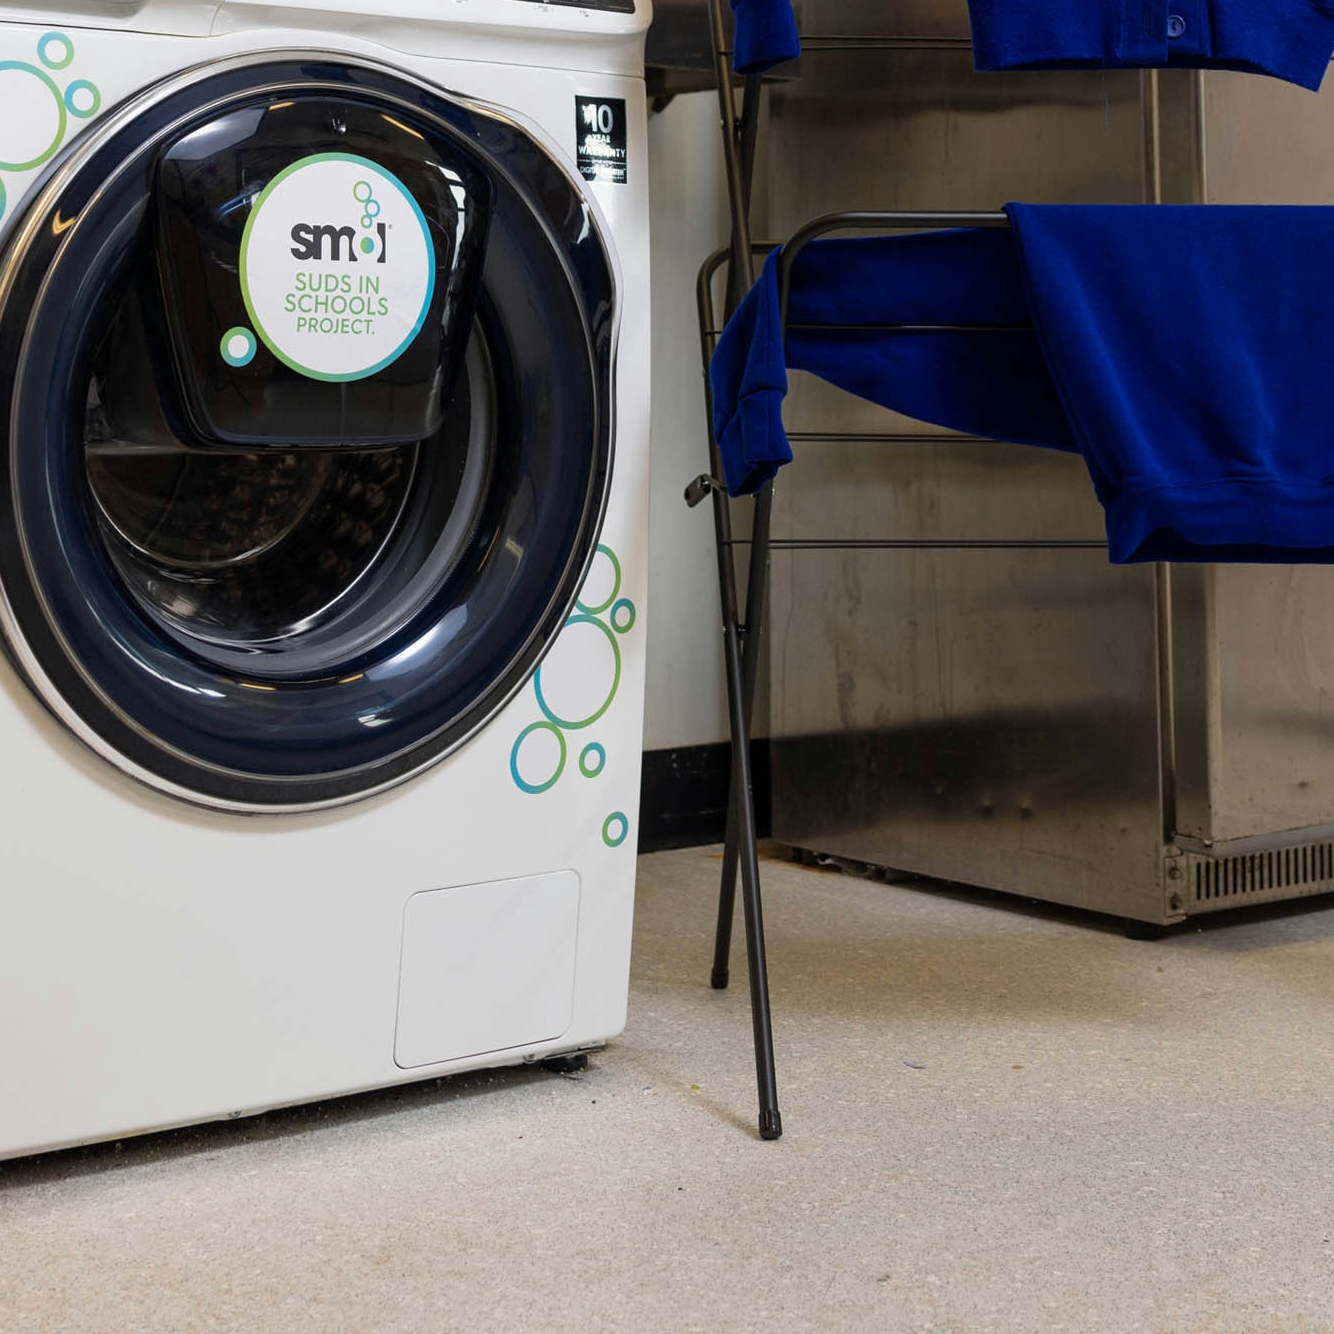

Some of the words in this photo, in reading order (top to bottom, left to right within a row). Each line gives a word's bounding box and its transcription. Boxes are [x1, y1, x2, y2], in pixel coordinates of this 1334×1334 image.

[290, 222, 387, 264] smol
[294, 272, 353, 294] SUDS
[358, 274, 380, 295] IN
[284, 292, 389, 316] SCHOOLS
[296, 316, 376, 335] PROJECT.
